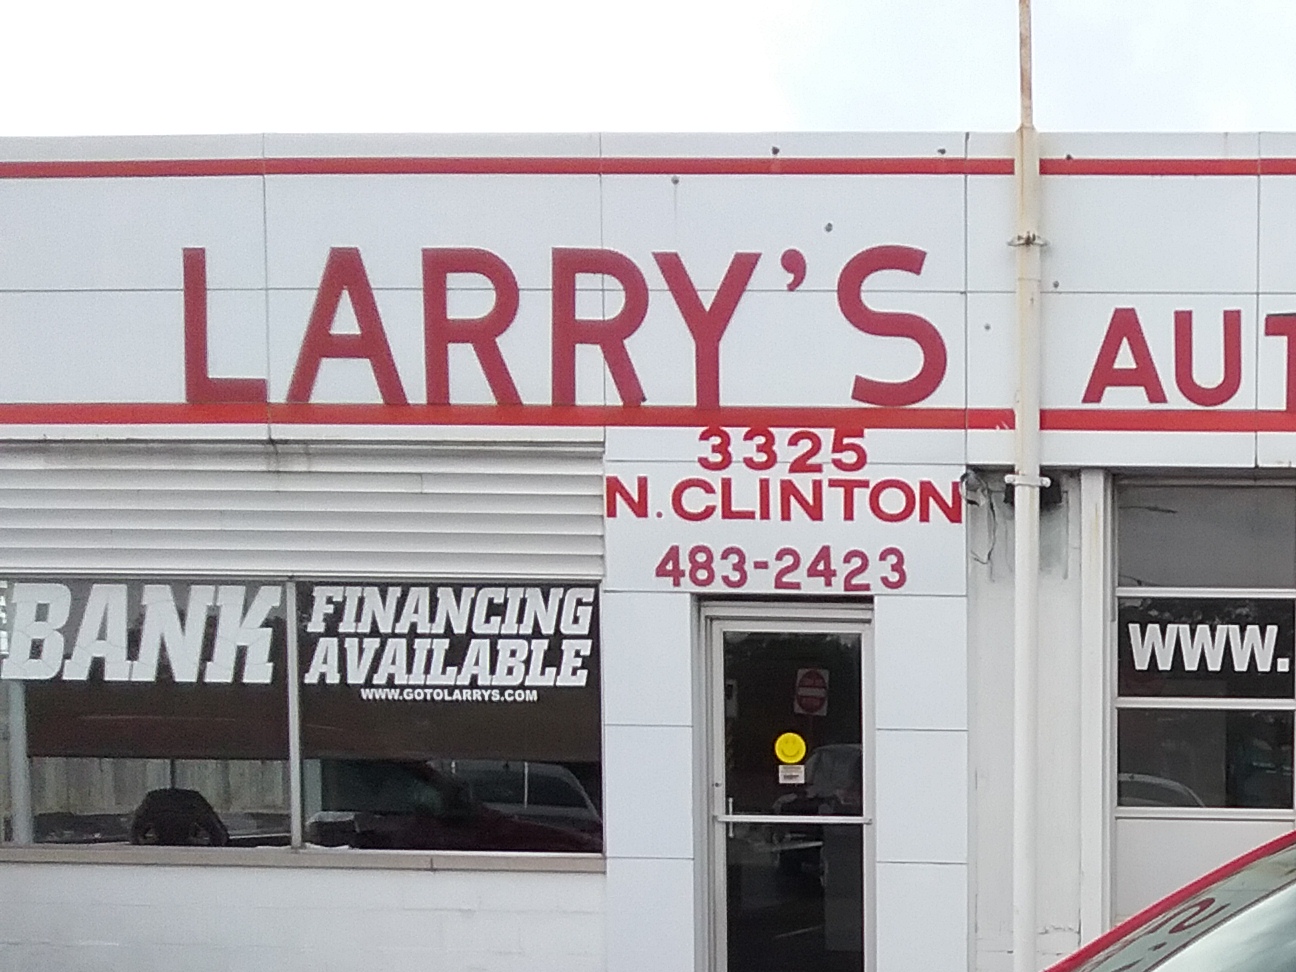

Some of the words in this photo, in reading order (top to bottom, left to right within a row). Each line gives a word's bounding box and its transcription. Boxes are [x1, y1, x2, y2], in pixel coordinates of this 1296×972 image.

[182, 245, 948, 407] LARRY'S
[697, 427, 868, 474] 3325
[655, 545, 907, 592] 483-2423
[1, 583, 281, 684] BANK
[307, 586, 596, 634] FINANCING
[304, 639, 592, 686] AVAILABLE
[360, 687, 538, 703] WWW.GOTOLARRYS.COM
